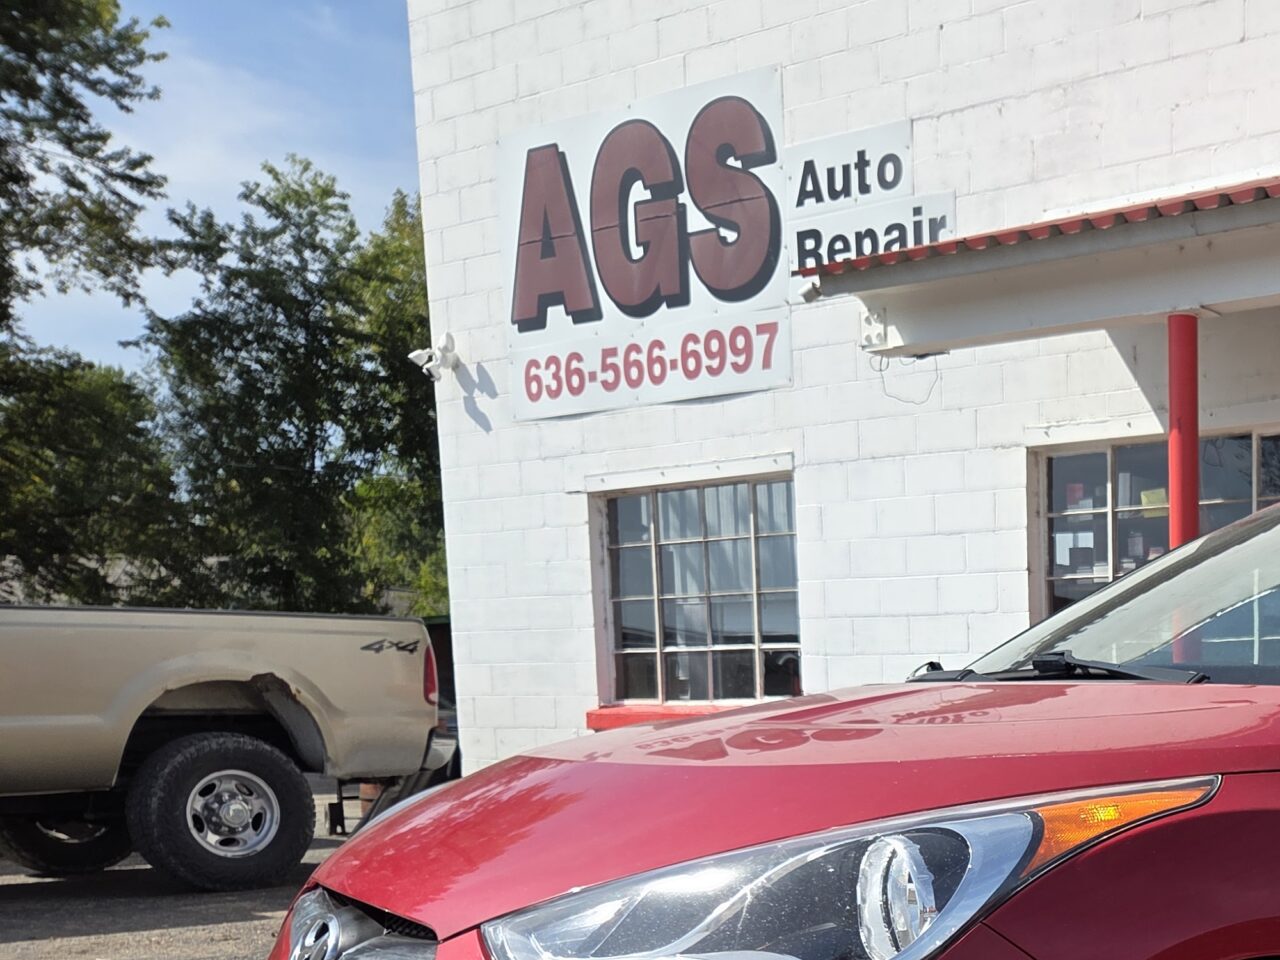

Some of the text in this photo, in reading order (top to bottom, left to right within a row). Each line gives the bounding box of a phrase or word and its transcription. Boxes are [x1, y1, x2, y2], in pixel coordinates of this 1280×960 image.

[511, 95, 782, 333] AGS
[796, 149, 903, 207] Auto
[796, 206, 947, 271] Repair
[524, 321, 779, 402] 636-566-6997
